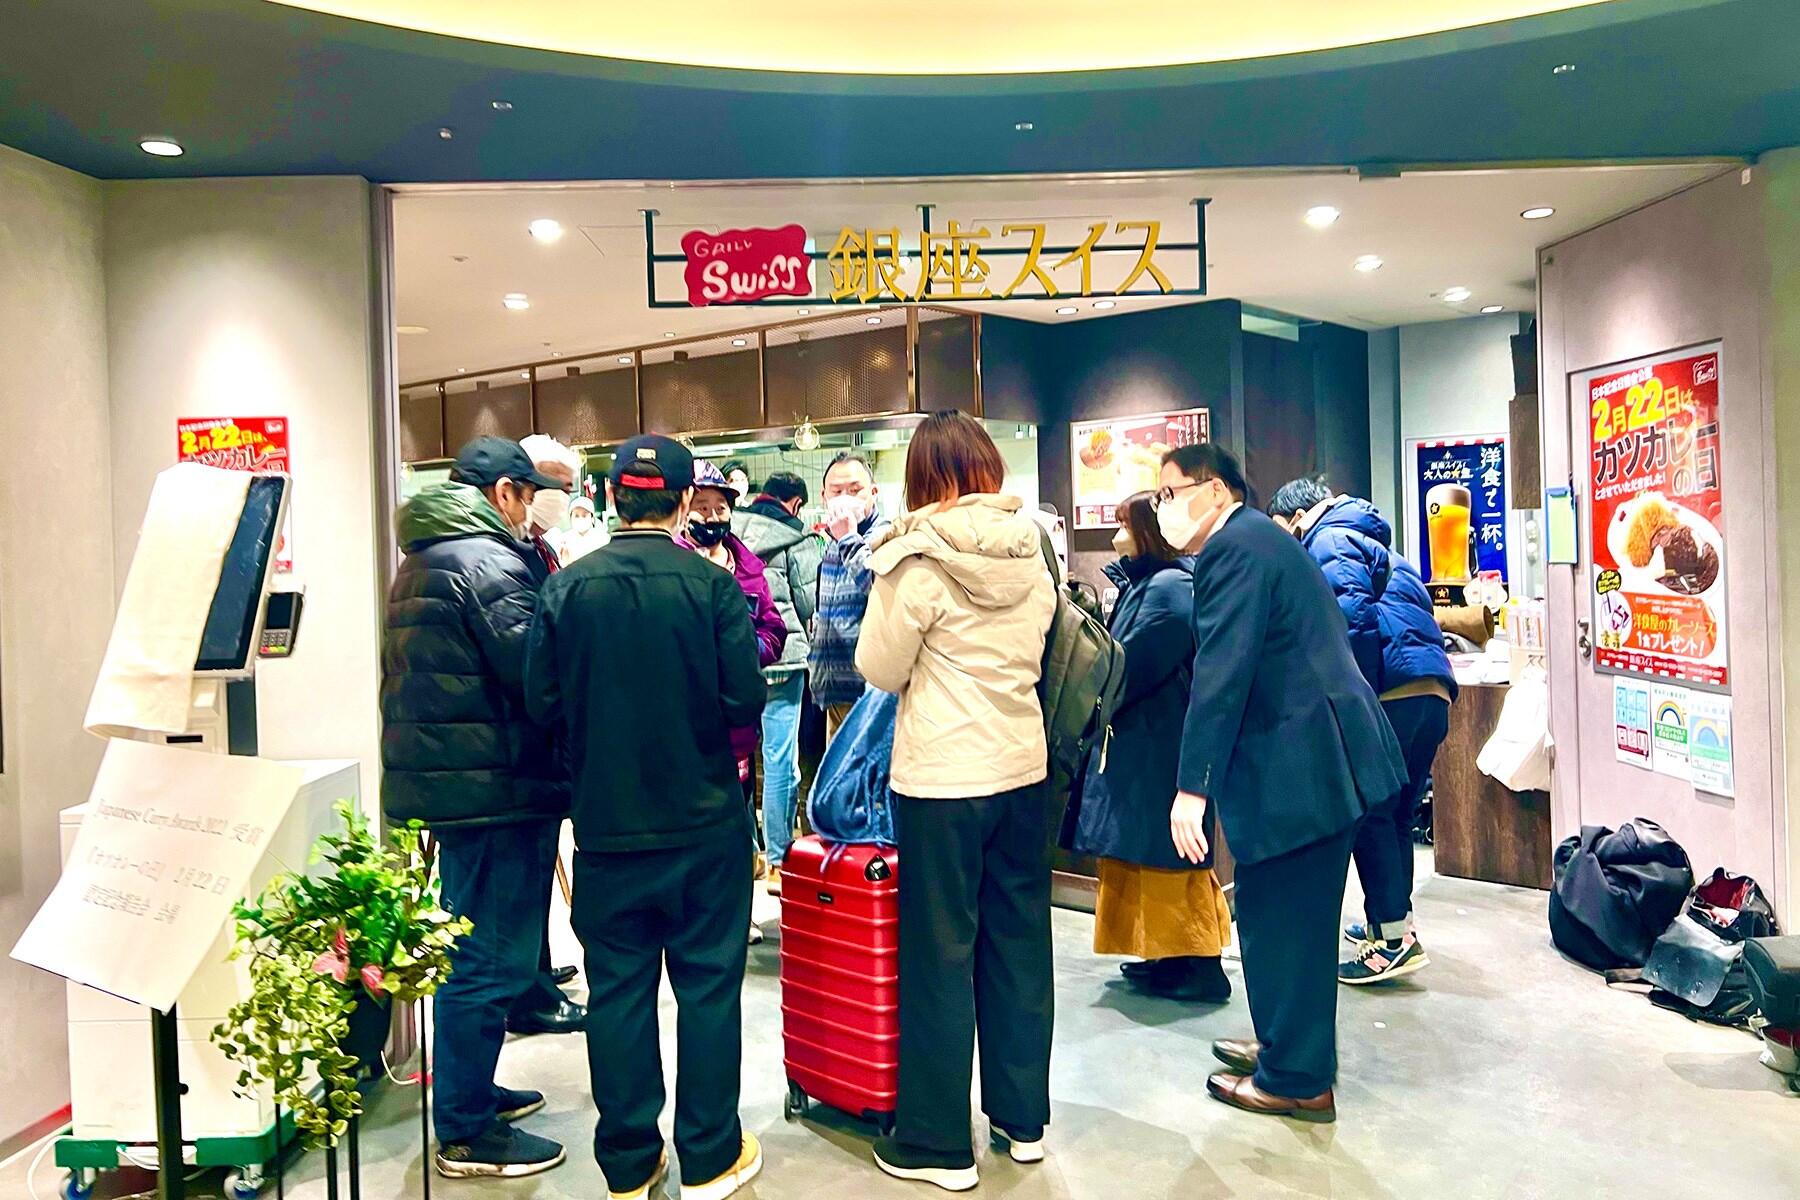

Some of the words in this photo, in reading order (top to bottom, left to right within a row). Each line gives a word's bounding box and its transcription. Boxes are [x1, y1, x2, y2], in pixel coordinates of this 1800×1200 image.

[826, 220, 1176, 303] 銀座スイス
[1594, 417, 1719, 485] カツカレー
